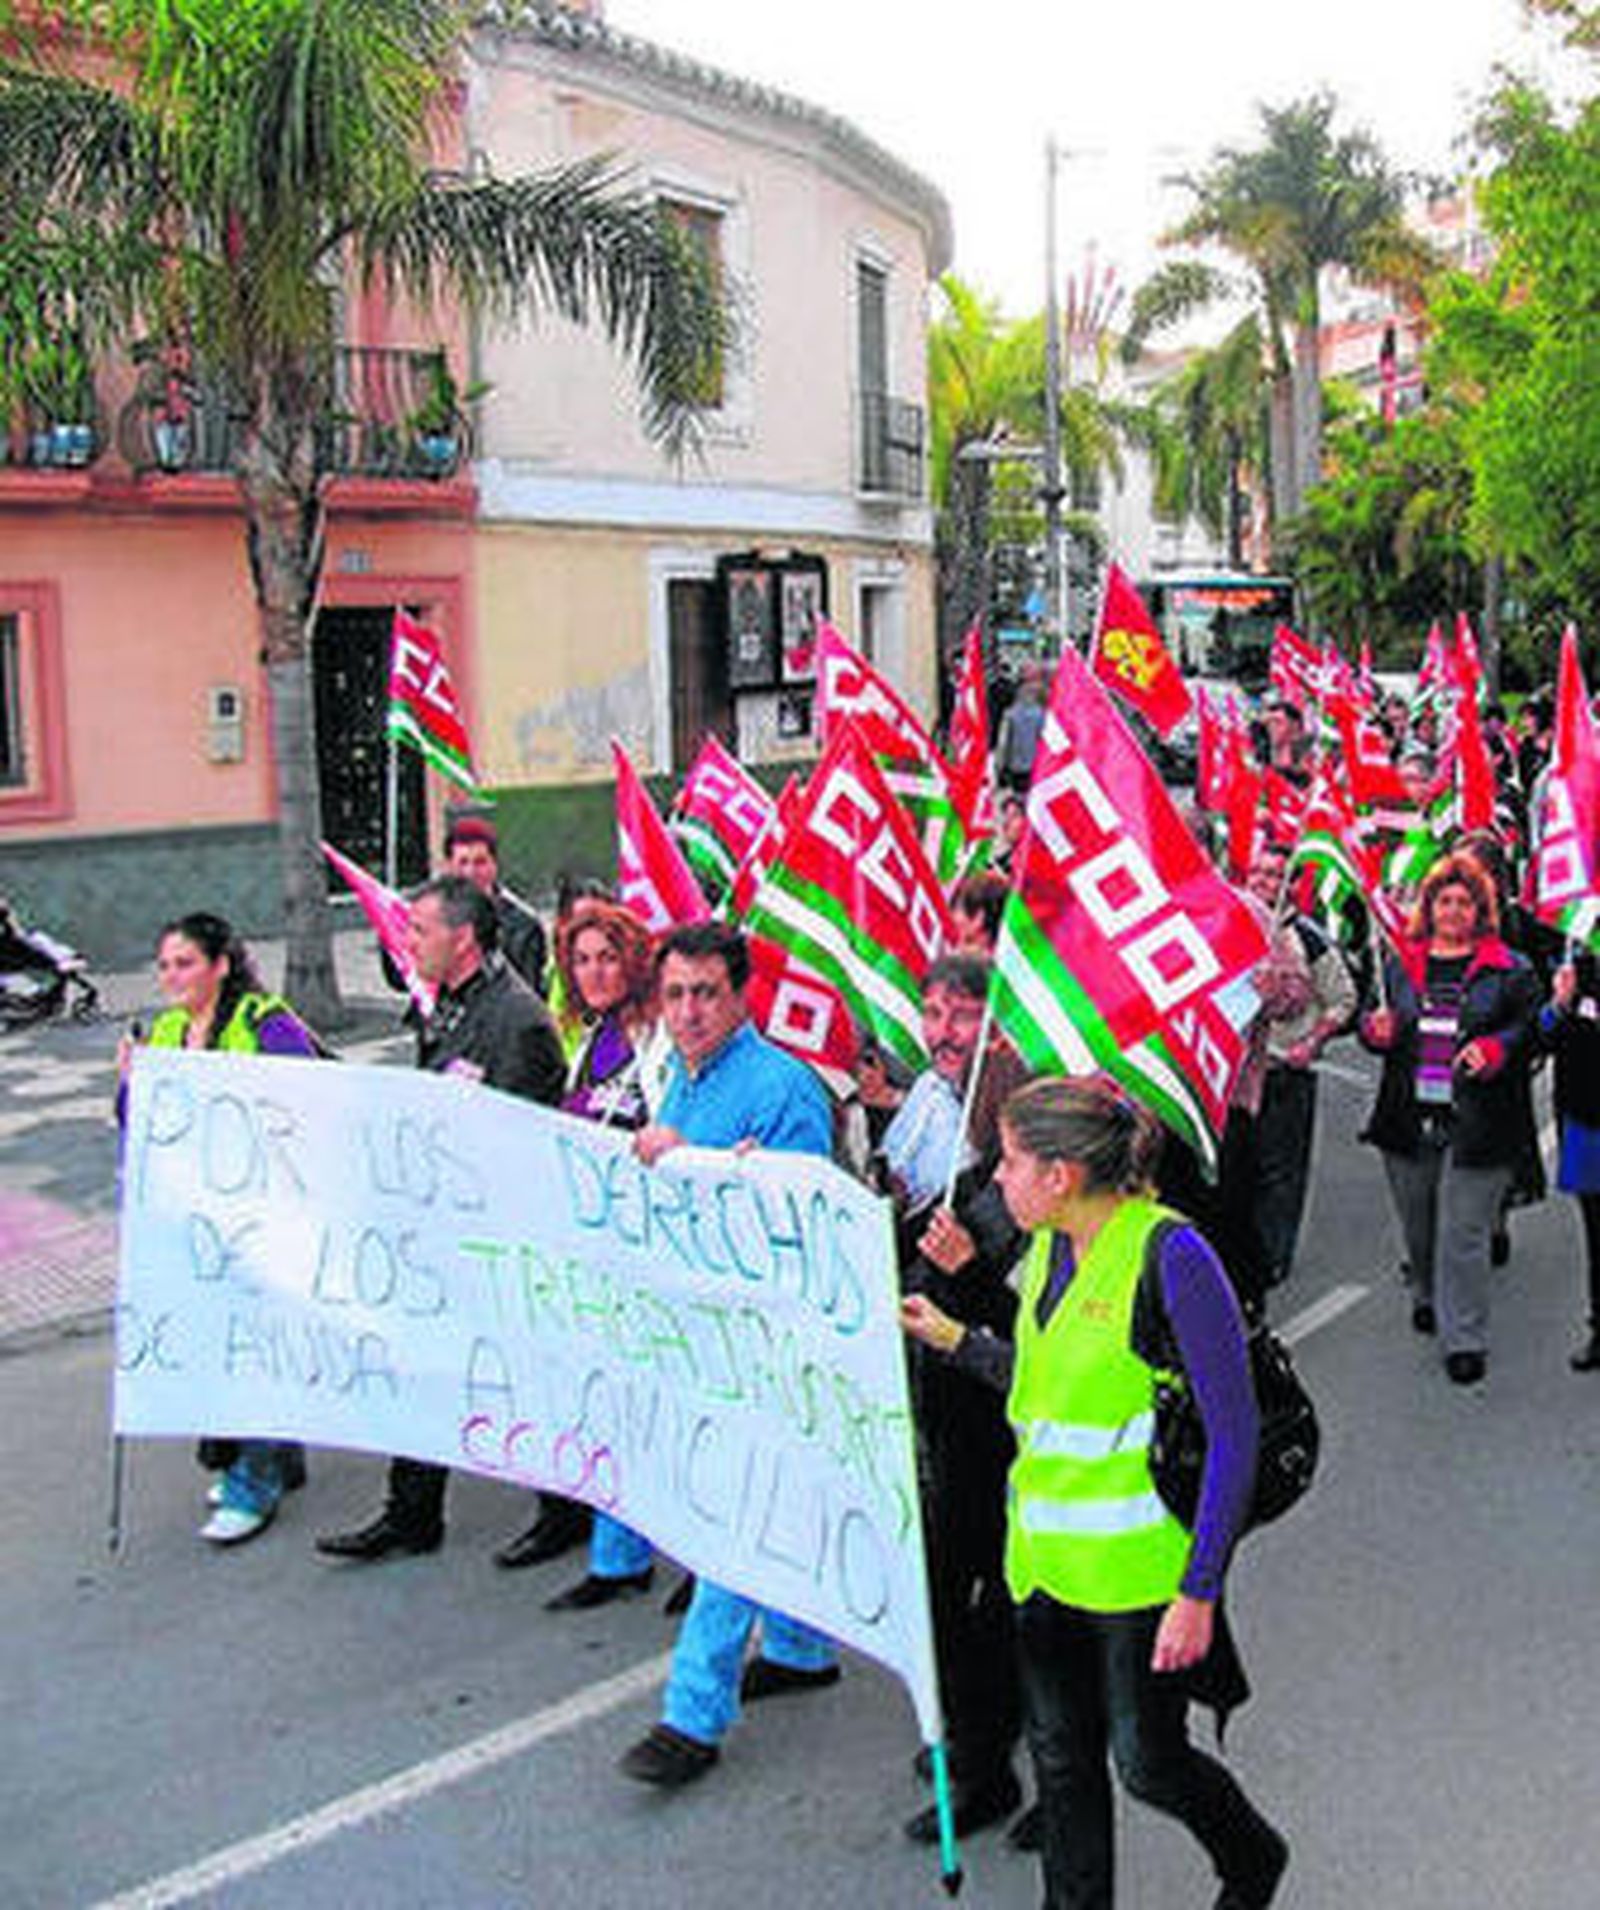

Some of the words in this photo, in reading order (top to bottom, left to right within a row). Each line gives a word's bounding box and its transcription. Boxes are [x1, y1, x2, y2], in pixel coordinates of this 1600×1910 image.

[137, 1078, 308, 1206] POR
[557, 1134, 867, 1336] DERECHOS
[311, 1224, 450, 1317] LOS
[464, 1336, 516, 1420] A
